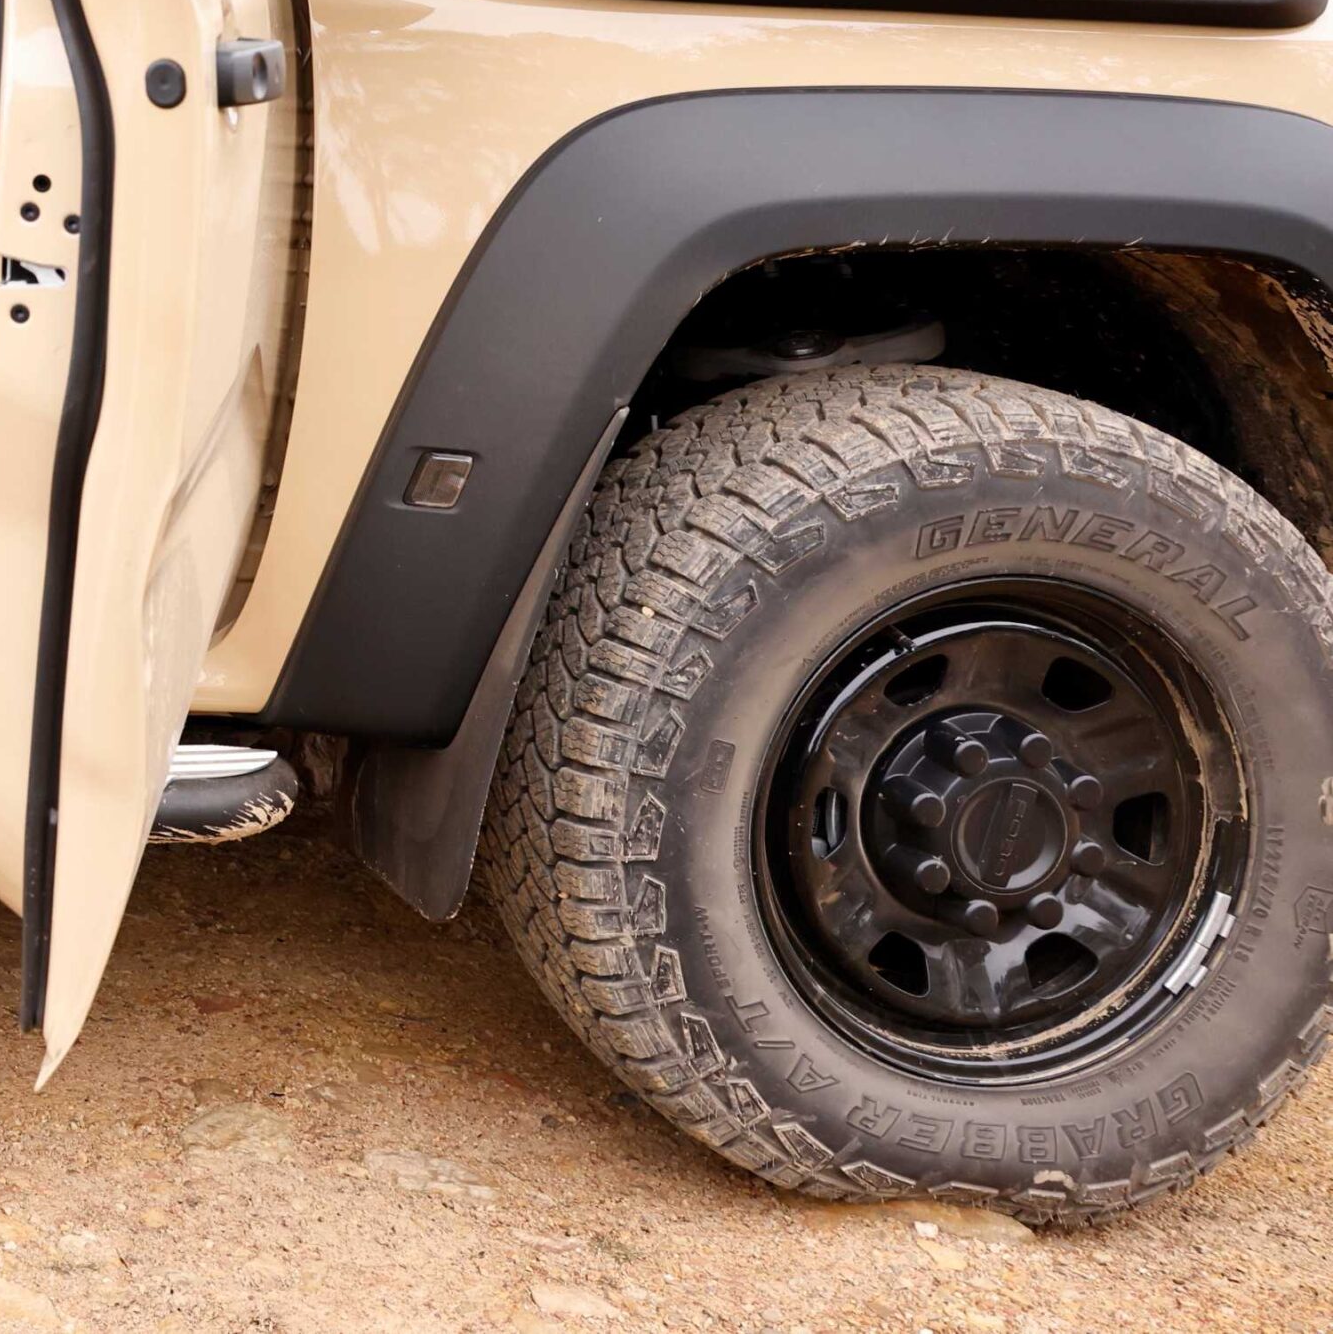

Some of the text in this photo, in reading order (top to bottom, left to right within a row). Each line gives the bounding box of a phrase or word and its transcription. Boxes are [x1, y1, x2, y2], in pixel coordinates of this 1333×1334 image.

[916, 503, 1259, 642] GENERAL
[994, 798, 1028, 877] FORD
[723, 998, 839, 1092] A/T
[843, 1068, 1203, 1170] GRABBER
